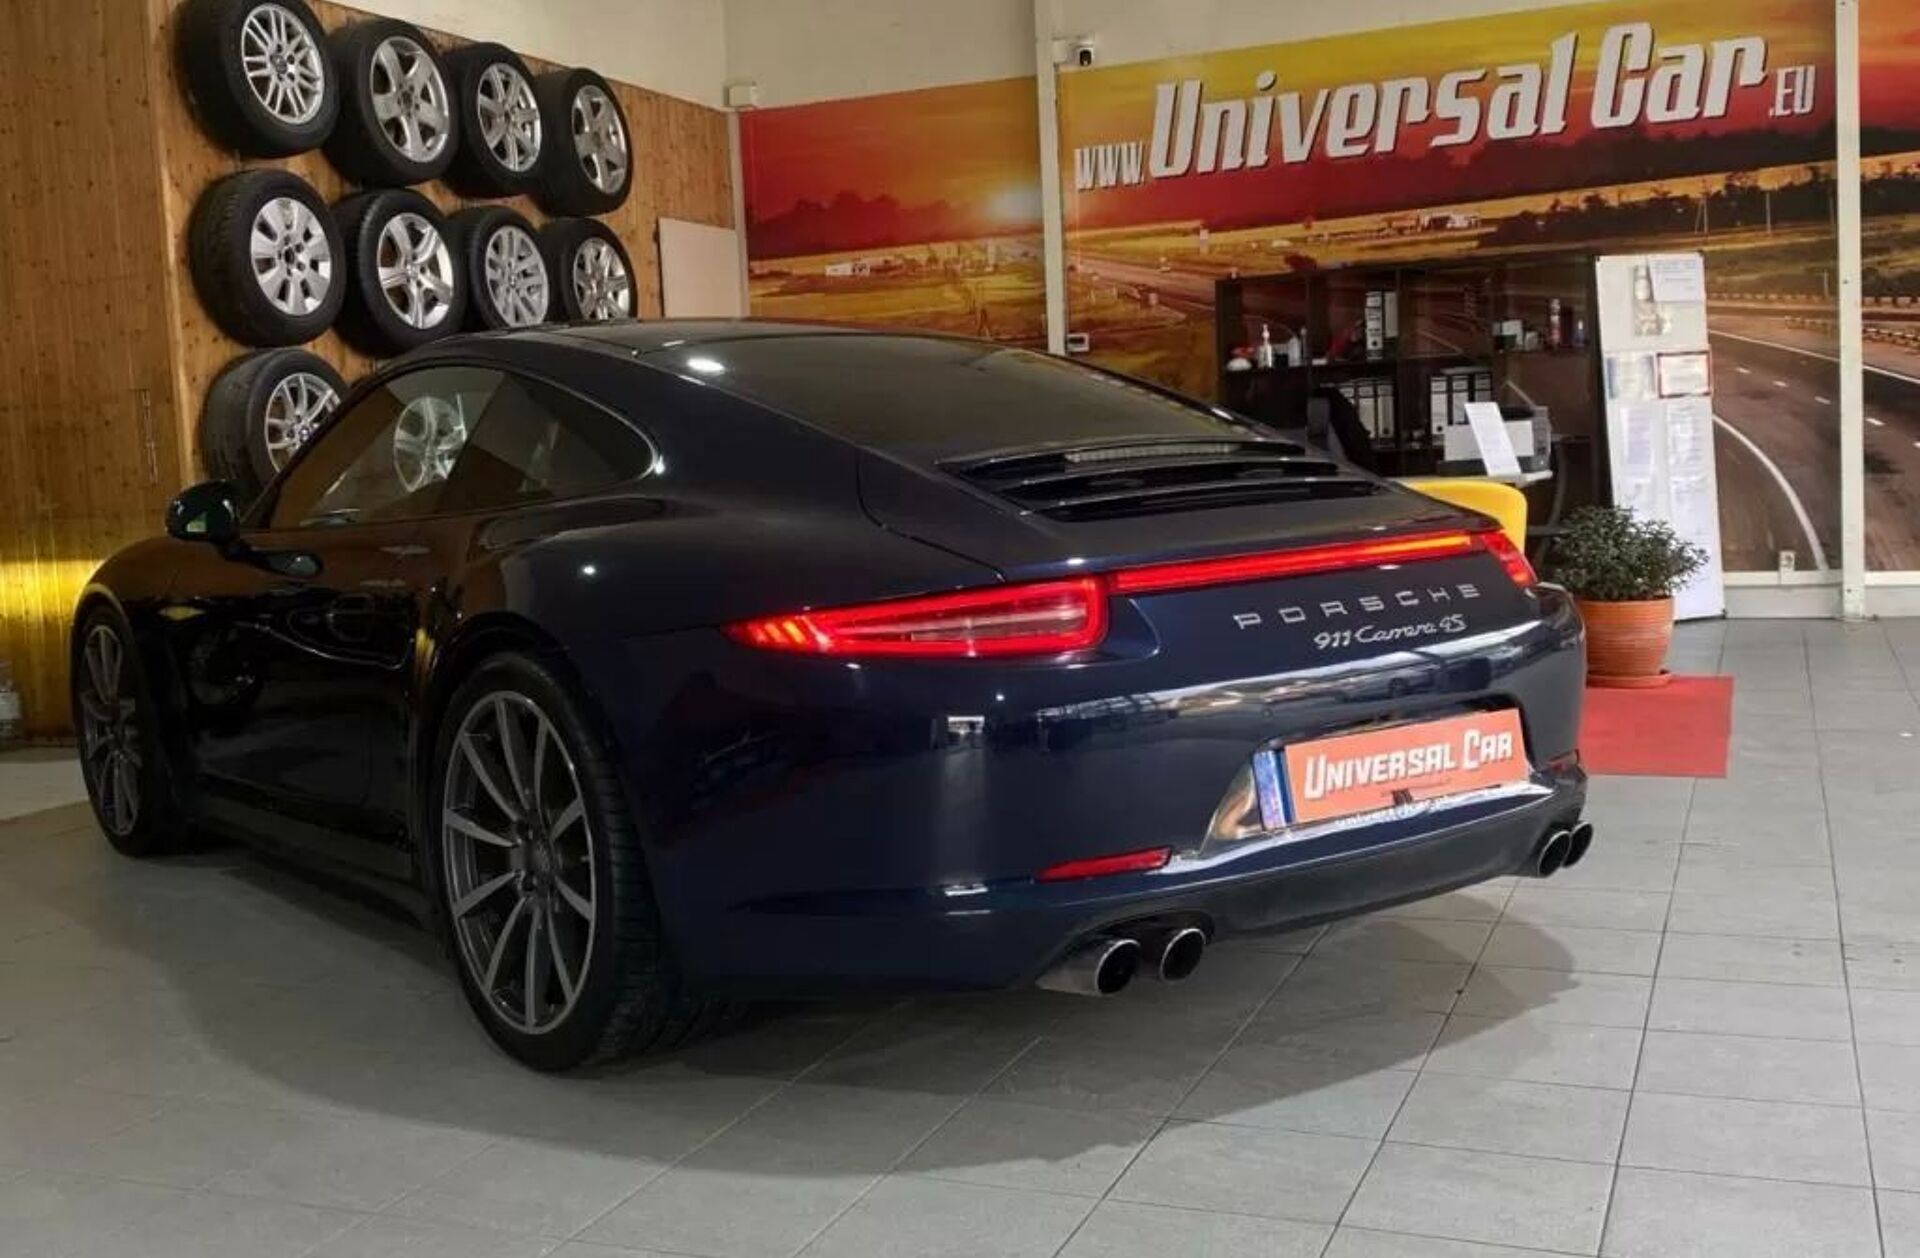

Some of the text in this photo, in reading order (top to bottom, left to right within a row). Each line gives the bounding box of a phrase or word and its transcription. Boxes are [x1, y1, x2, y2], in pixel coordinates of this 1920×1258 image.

[1233, 583, 1481, 630] PORSCHE
[1313, 613, 1468, 649] 911 Carrera 4S
[1303, 729, 1513, 799] UNIVERSAL CAR
